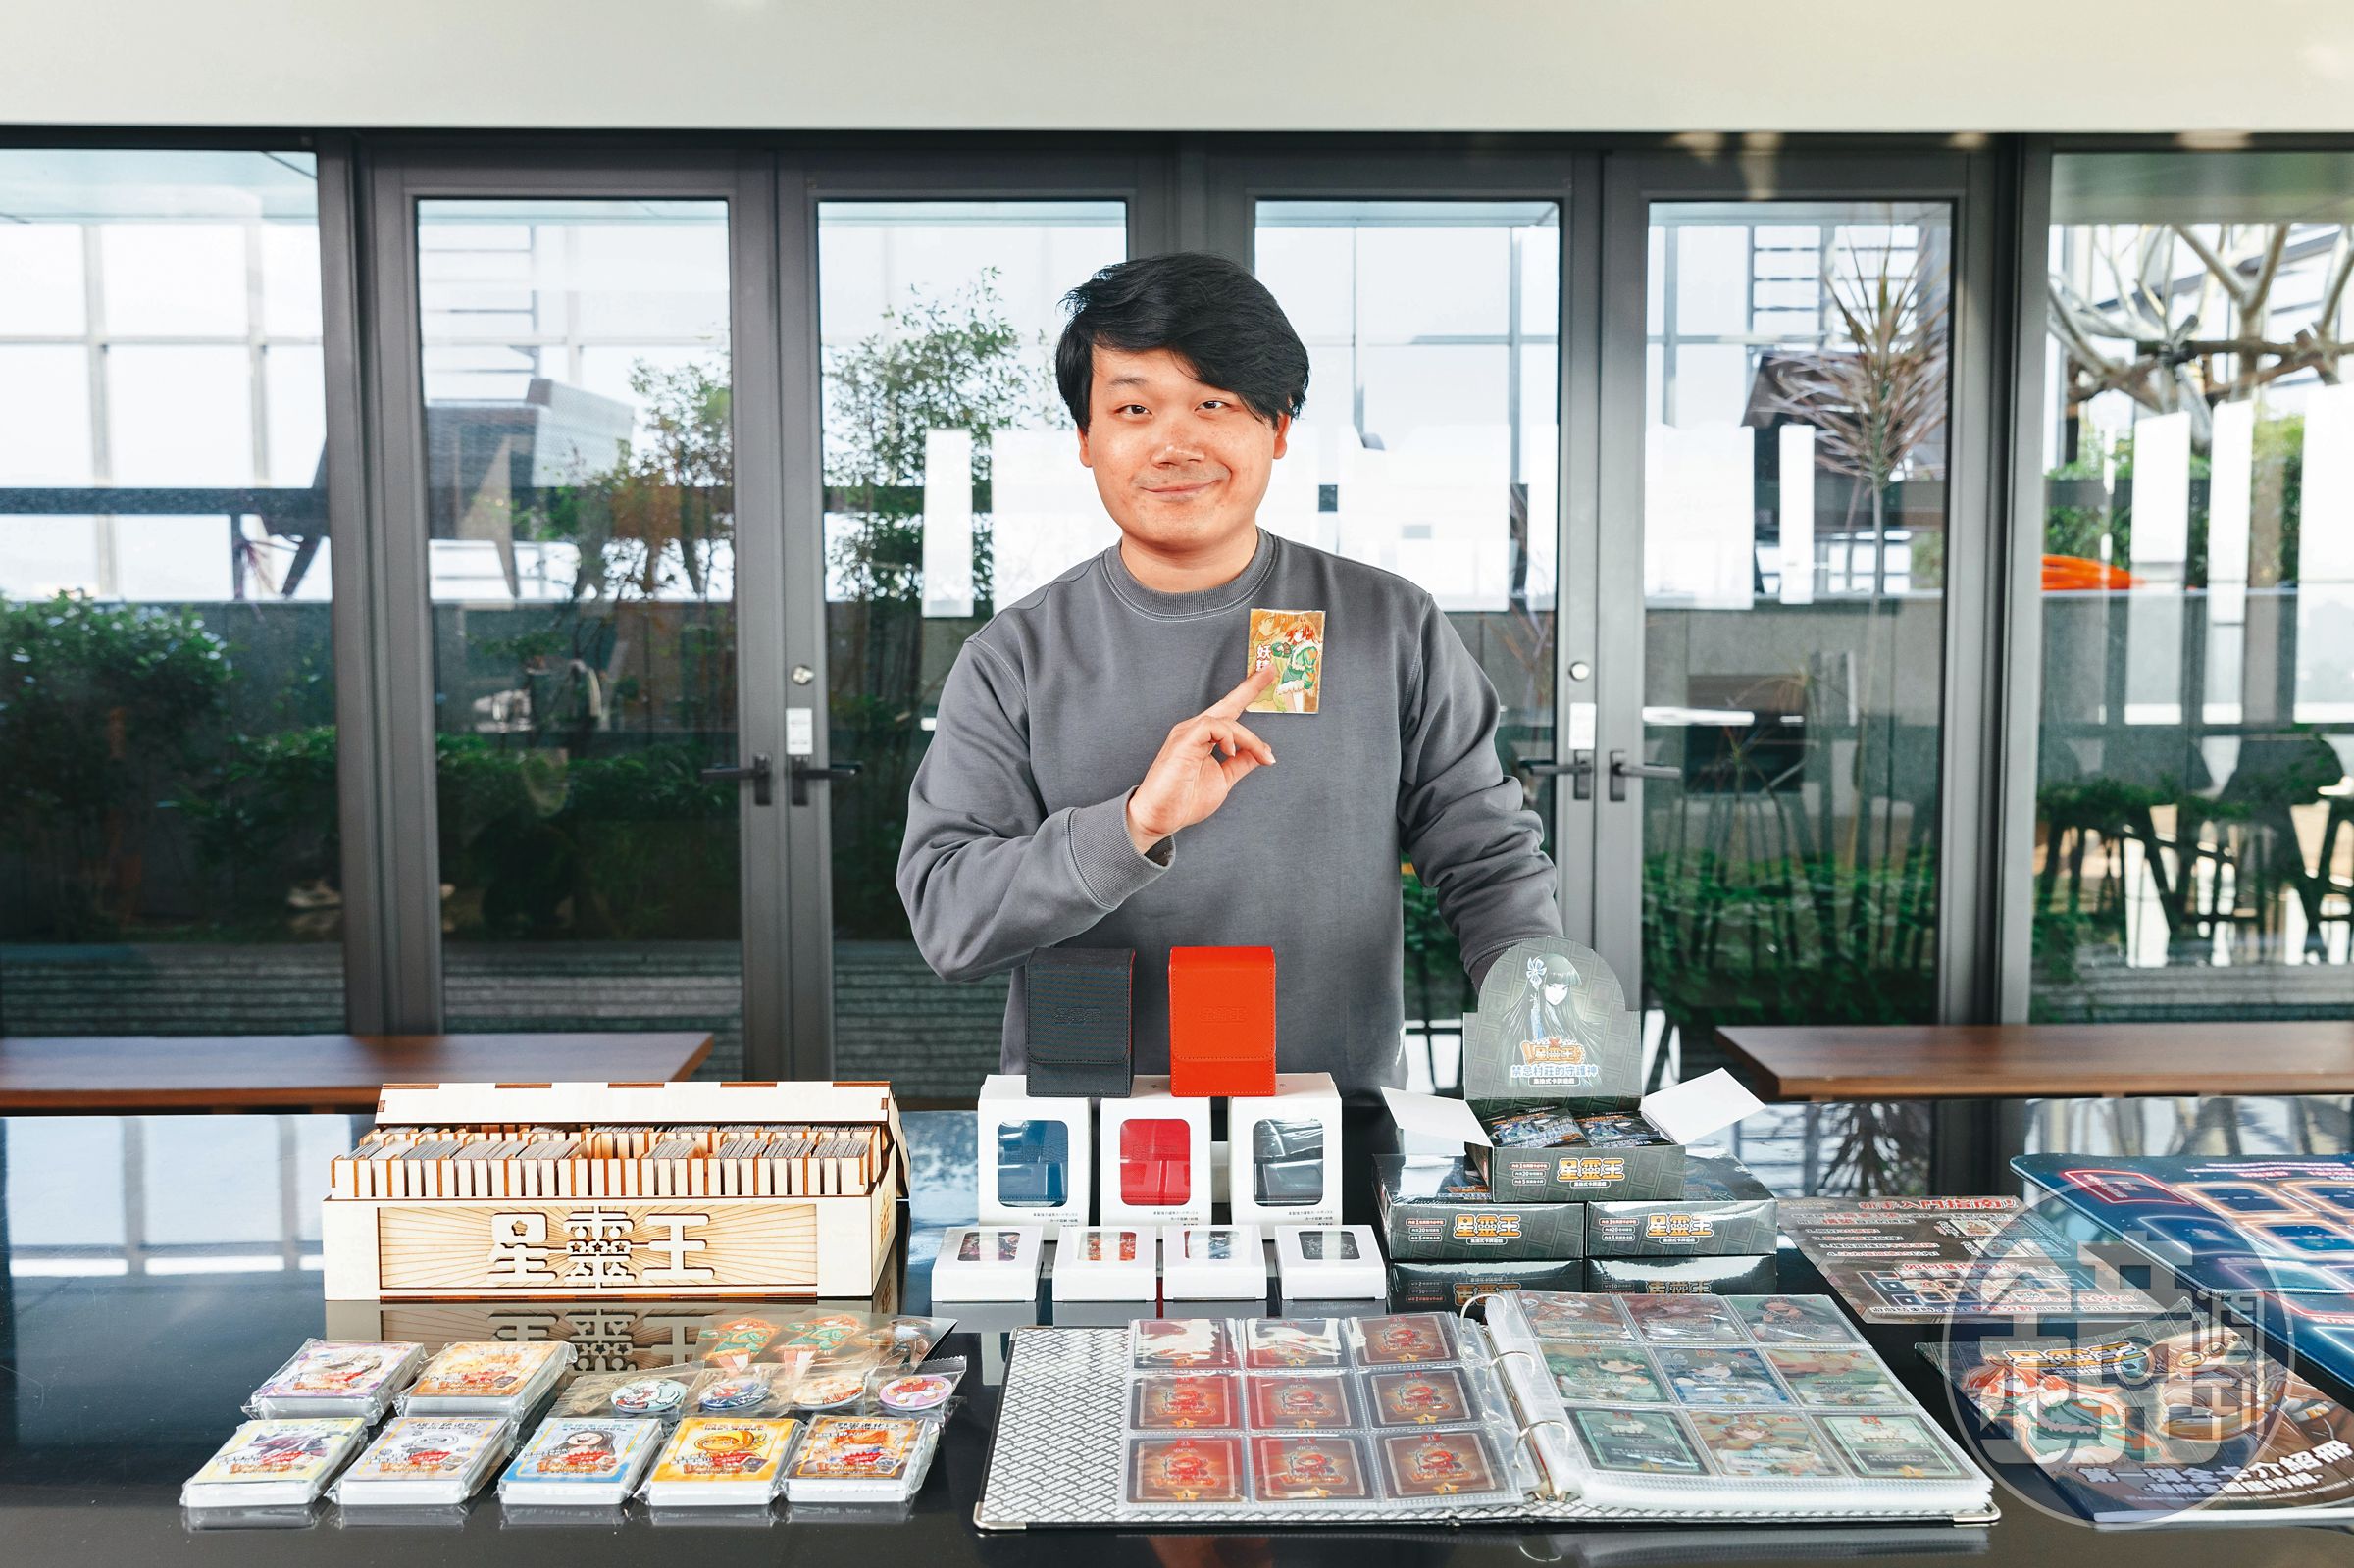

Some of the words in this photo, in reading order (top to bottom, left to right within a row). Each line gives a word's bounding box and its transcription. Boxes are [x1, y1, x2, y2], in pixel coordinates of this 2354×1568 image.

[1511, 1065, 1599, 1077] 禁忌村莊的守護神
[1557, 1158, 1625, 1182] 星靈王
[1454, 1214, 1521, 1238] 星靈王
[1646, 1213, 1714, 1238] 星靈王
[486, 1208, 715, 1288] 星靈王
